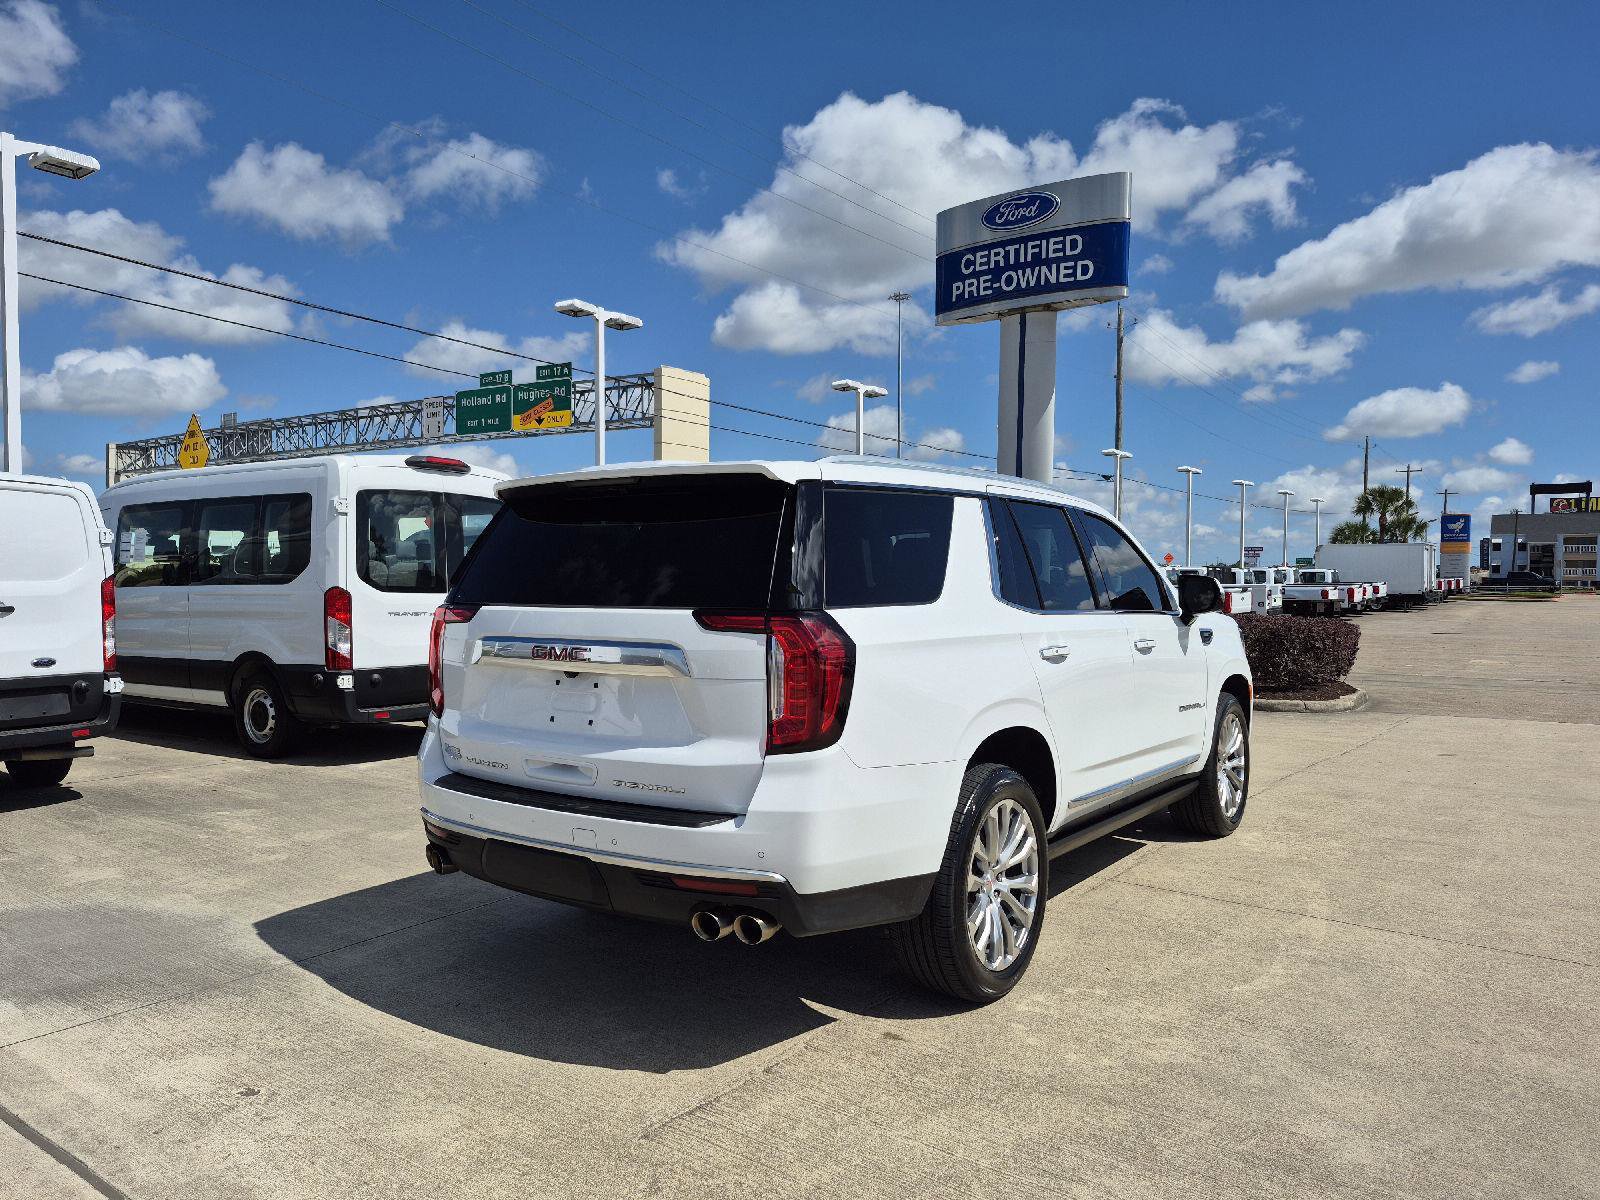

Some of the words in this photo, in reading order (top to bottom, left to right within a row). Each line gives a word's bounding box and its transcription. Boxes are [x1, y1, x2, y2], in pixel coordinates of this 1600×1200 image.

[996, 198, 1039, 224] Ford
[961, 234, 1083, 275] CERTIFIED
[952, 260, 1094, 302] PRE-OWNED
[553, 367, 561, 376] 17
[563, 367, 569, 375] A
[461, 395, 492, 407] Holland
[495, 393, 507, 403] Rd
[518, 389, 550, 401] Hughes
[554, 386, 566, 397] Rd
[424, 401, 443, 410] SPEED
[481, 418, 485, 427] 1
[546, 415, 565, 424] ONLY
[531, 644, 592, 662] GMC
[466, 755, 509, 770] YUKON
[612, 778, 686, 794] DENALI
